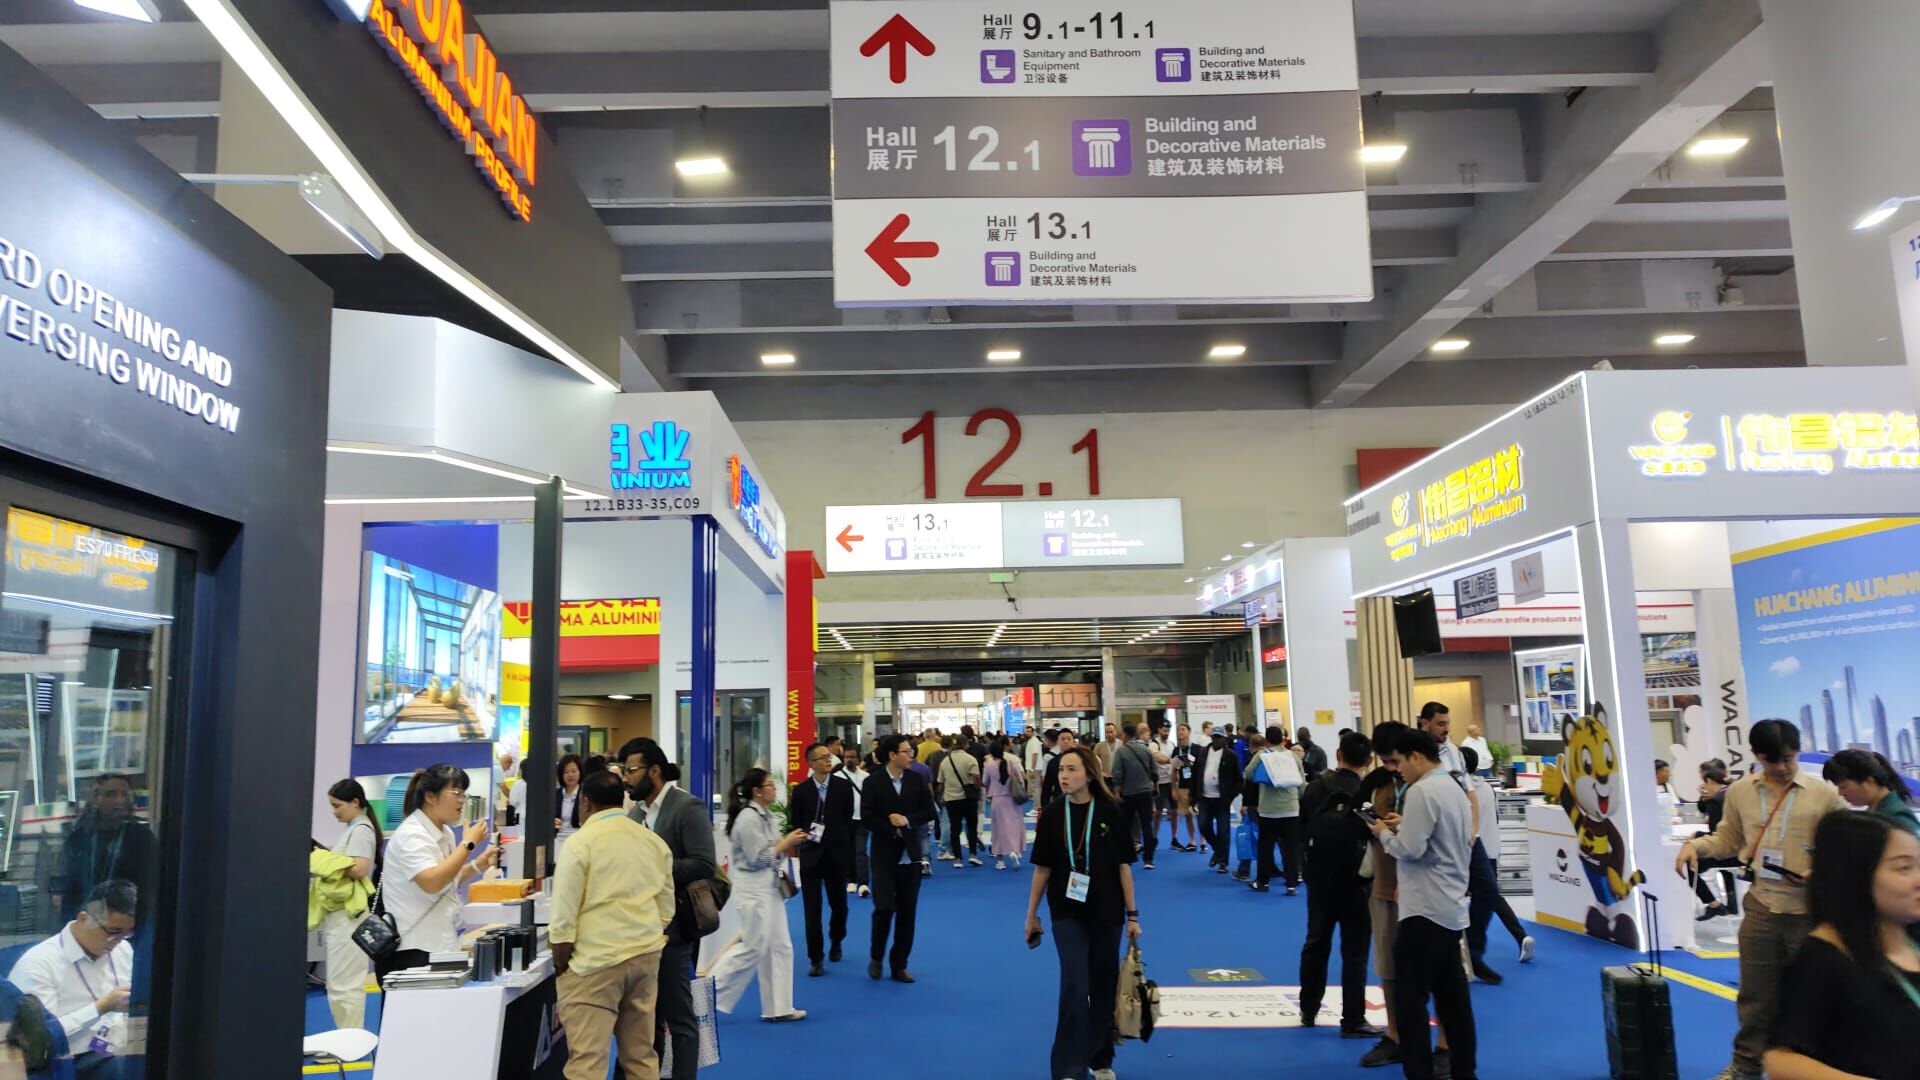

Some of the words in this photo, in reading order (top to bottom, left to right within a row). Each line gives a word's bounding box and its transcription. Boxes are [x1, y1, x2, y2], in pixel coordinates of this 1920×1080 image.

[983, 14, 1013, 26] Hall
[982, 28, 1013, 40] 展厅
[1023, 49, 1066, 60] Sanitary
[1068, 49, 1088, 58] and
[1090, 48, 1141, 58] Bathroom
[1199, 46, 1243, 57] Building
[1245, 46, 1265, 55] and
[1023, 61, 1080, 72] Equipment
[1200, 59, 1255, 68] Decorative
[1258, 57, 1305, 67] Materials
[1023, 73, 1068, 84] 卫浴设备
[1201, 69, 1281, 81] 建筑及装饰材料
[369, 0, 472, 142] ALUMINIUM
[474, 131, 532, 223] PROFILE
[1145, 117, 1219, 136] Building
[1223, 116, 1257, 131] and
[867, 126, 916, 147] Hall
[932, 125, 1040, 172] 12.1
[1146, 138, 1241, 154] Decorative
[1245, 134, 1327, 152] Materials
[866, 149, 918, 171] 展厅
[1147, 156, 1285, 177] 建筑及装饰材料
[986, 215, 1017, 227] Hall
[1027, 212, 1091, 240] 13.1
[986, 229, 1017, 242] 展厅
[1029, 251, 1074, 262] Building
[1076, 250, 1096, 261] and
[1029, 263, 1087, 273] Decorative
[1089, 262, 1137, 273] Materials
[1030, 275, 1112, 287] 建筑及装饰材料
[48, 268, 181, 361] OPENING
[180, 339, 232, 388] AND
[135, 357, 240, 433] WINDOW
[902, 407, 1100, 499] 12.1
[1070, 509, 1110, 528] 12.1
[75, 535, 113, 558] ES70
[114, 543, 159, 568] FRESH
[1754, 583, 1842, 618] HUACHANG
[928, 690, 960, 704] 10.1
[1047, 687, 1095, 709] 10.1
